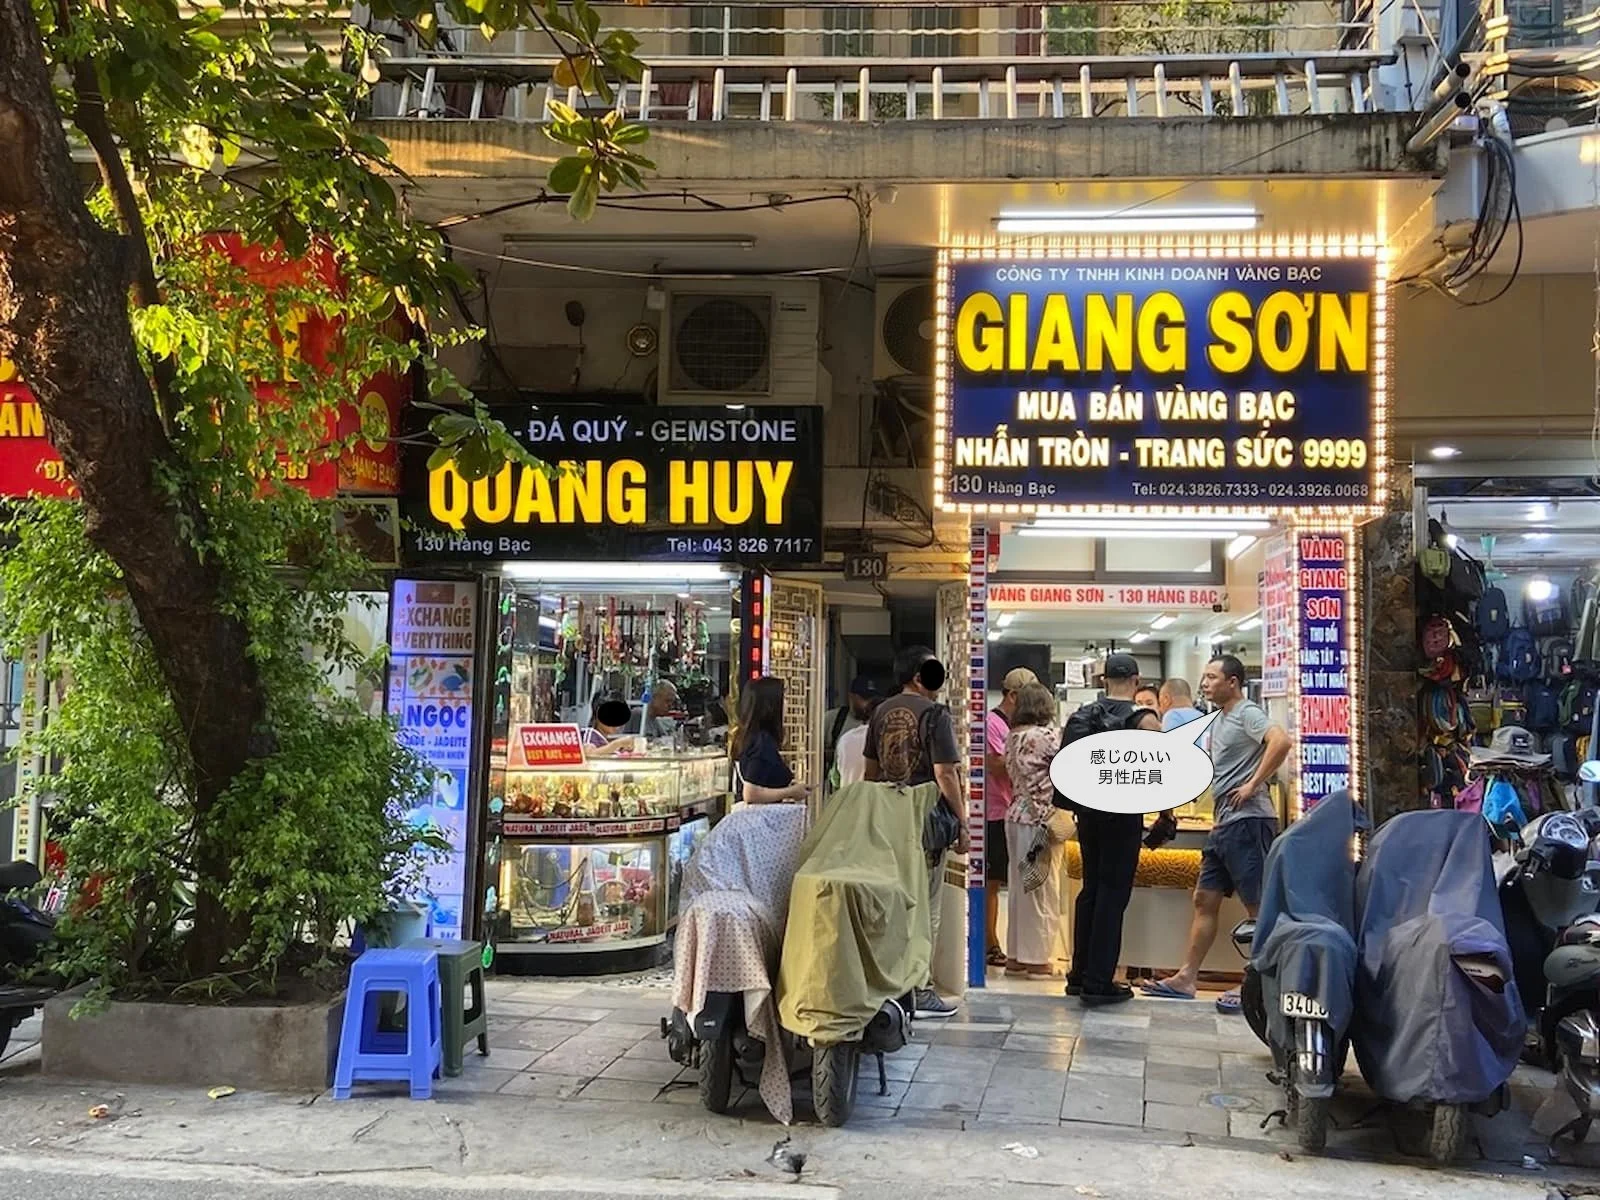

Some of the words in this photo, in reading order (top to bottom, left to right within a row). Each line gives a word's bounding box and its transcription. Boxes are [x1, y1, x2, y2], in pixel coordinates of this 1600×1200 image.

[996, 263, 1042, 281] CÔNG
[1048, 268, 1070, 281] TY
[1075, 268, 1120, 281] TNHH
[1125, 268, 1165, 281] KINH
[1171, 268, 1229, 281] DOANH
[1235, 263, 1281, 281] VÀNG
[1286, 267, 1322, 284] BẠC
[955, 290, 1187, 374] GIANG
[1206, 289, 1369, 374] SƠN
[1017, 390, 1076, 421] MUA
[1088, 383, 1144, 421] BÁN
[1155, 383, 1229, 421] VÀNG
[1238, 390, 1296, 428] BẠC
[528, 415, 566, 442] ĐÁ
[572, 415, 628, 443] QUÝ
[651, 420, 797, 443] GEMSTONE
[955, 423, 1030, 468] NHẪN
[1038, 430, 1110, 468] TRÒN
[1135, 437, 1226, 469] TRANG
[1236, 430, 1294, 469] SỨC
[1303, 438, 1367, 469] 9999
[429, 457, 647, 530] QUANG
[669, 459, 794, 525] HUY
[951, 475, 982, 493] 130
[987, 480, 1024, 496] Hàng
[1028, 481, 1056, 498] Bạc
[1132, 483, 1156, 496] Tel:
[415, 537, 444, 551] 130
[449, 536, 494, 556] Hàng
[499, 536, 531, 556] Bạc
[667, 538, 697, 552] Tel:
[702, 538, 733, 552] 043
[738, 538, 768, 552] 826
[774, 538, 813, 552] 7117
[1301, 535, 1344, 560] VÀNG
[851, 558, 883, 577] 130
[1299, 567, 1347, 590] GIANG
[989, 585, 1026, 602] VÀNG
[1030, 588, 1072, 602] GIANG
[1076, 587, 1105, 603] SƠN
[1119, 590, 1143, 604] 130
[1148, 586, 1185, 604] HÀNG
[1190, 590, 1218, 607] BẠC
[399, 607, 471, 628] EXCHANGE
[1307, 596, 1341, 620] SƠN
[394, 632, 473, 650] EVERYTHING
[407, 704, 467, 733] NGỌC
[1300, 694, 1350, 737] EXCHANGE
[522, 731, 579, 747] EXCHANGE
[1303, 772, 1325, 794] BEST
